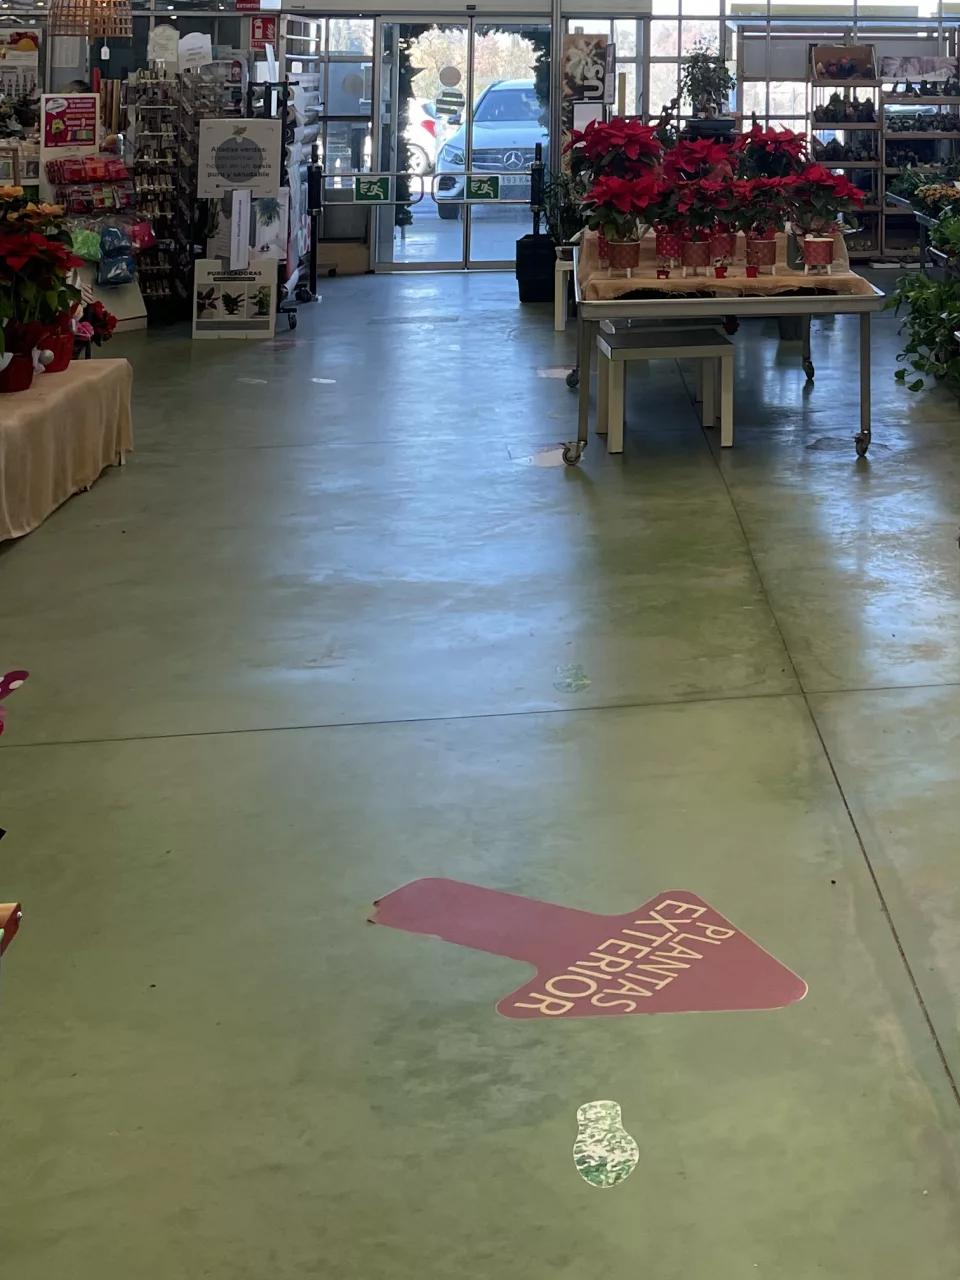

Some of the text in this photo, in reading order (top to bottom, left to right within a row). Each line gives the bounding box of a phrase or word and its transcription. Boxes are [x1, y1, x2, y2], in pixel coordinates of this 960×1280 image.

[583, 63, 604, 98] US
[513, 899, 708, 1016] EXTERIOR
[590, 922, 736, 1012] PLANTAS
